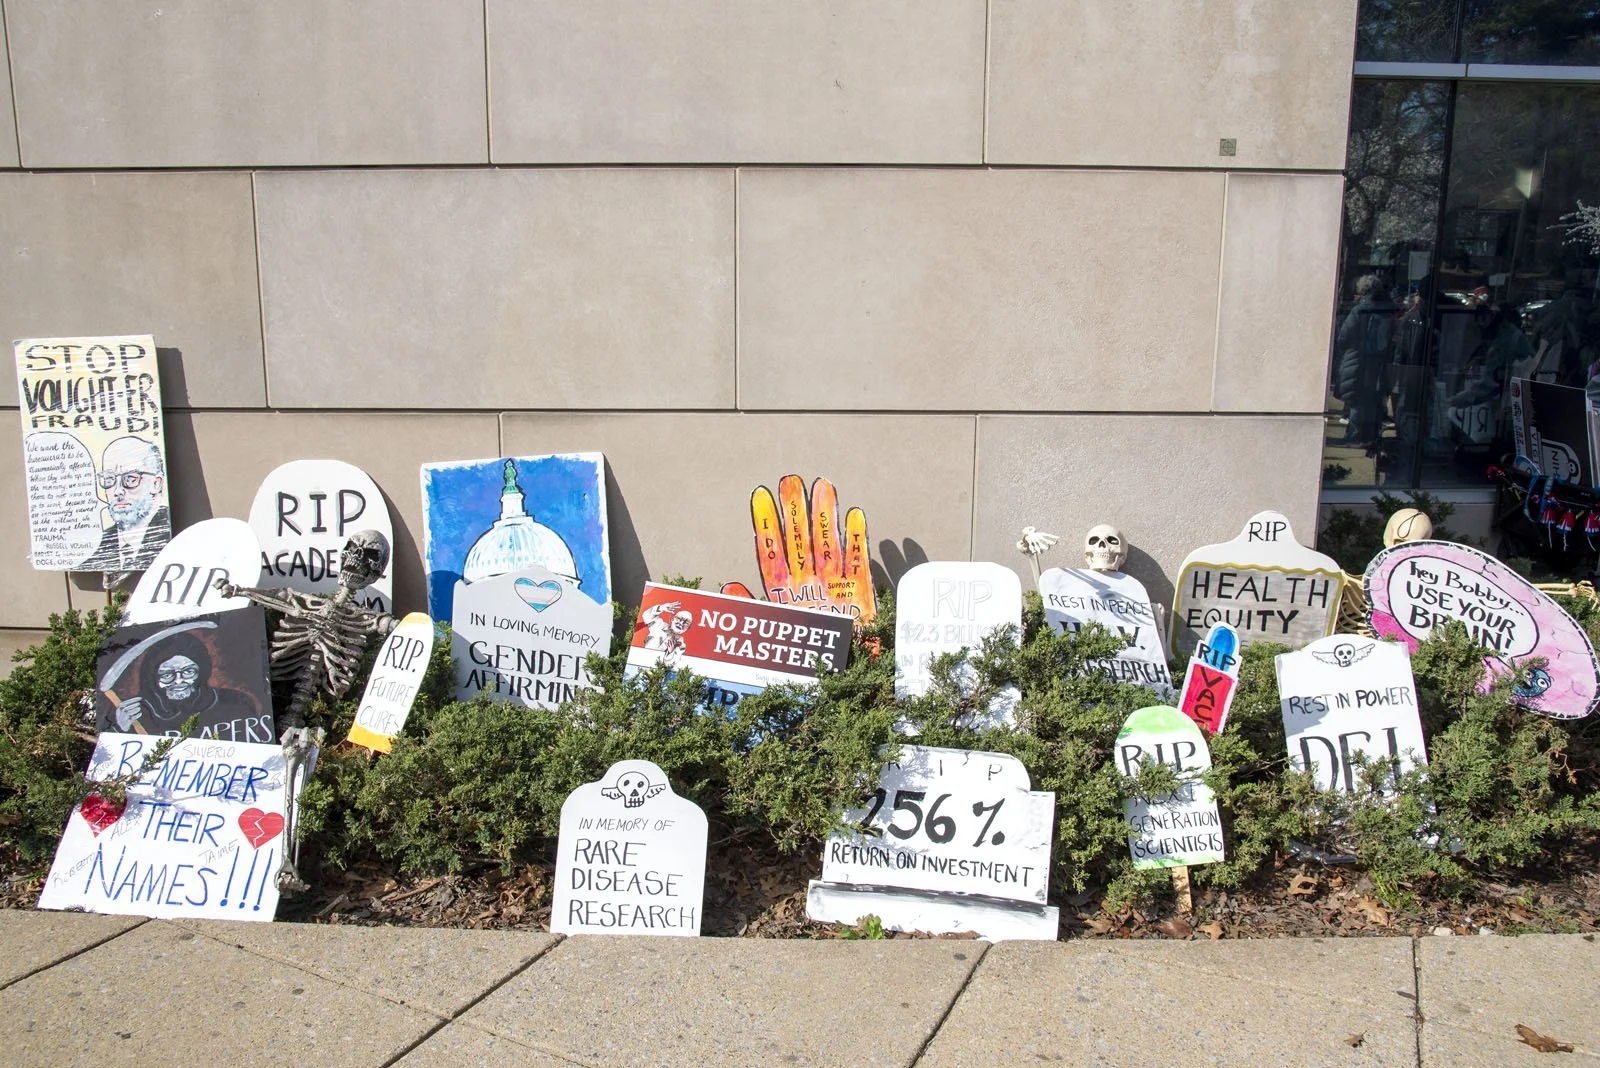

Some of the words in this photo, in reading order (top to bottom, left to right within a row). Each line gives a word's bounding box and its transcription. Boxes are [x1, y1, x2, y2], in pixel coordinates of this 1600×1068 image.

[25, 344, 146, 374] STOP
[62, 440, 75, 450] the
[76, 450, 84, 458] be
[277, 489, 366, 537] RIP
[763, 519, 768, 529] I
[790, 501, 805, 570] SOLEMNLY
[820, 512, 832, 561] SWEAR
[1248, 521, 1286, 542] RIP
[261, 547, 338, 582] ACADE
[851, 534, 861, 575] THAT
[150, 563, 230, 607] RIP
[772, 588, 787, 604] I
[789, 585, 827, 602] WILL
[827, 582, 855, 590] SUPPORT
[836, 591, 853, 599] AND
[933, 577, 992, 620] RIP
[1192, 570, 1329, 608] HEALTH
[1049, 594, 1085, 609] REST
[1091, 599, 1106, 611] IN
[1109, 600, 1149, 615] PEACE
[1406, 581, 1453, 611] USE
[1458, 598, 1516, 641] YOUR
[470, 612, 486, 626] IN
[494, 616, 540, 636] LOVING
[543, 625, 600, 648] MEMORY
[698, 609, 737, 634] NO
[741, 616, 841, 649] PUPPET
[1187, 608, 1299, 634] EQUITY
[469, 640, 591, 682] GENDER
[714, 635, 839, 673] MASTERS.
[1198, 643, 1236, 671] RIP
[464, 669, 594, 703] AFFIRMIN
[1082, 660, 1168, 684] ESEARCH
[369, 676, 414, 708] FUTURE
[1289, 693, 1333, 714] REST
[1336, 693, 1350, 709] IN
[1356, 686, 1413, 708] POWER
[165, 715, 272, 743] APERS
[360, 705, 399, 734] CURES
[181, 744, 235, 758] SILVERIO
[1121, 741, 1196, 776] RIP
[139, 801, 225, 847] THEIR
[578, 817, 593, 831] IN
[596, 817, 648, 831] MEMORY
[654, 820, 675, 831] OF
[1130, 808, 1219, 833] GENERATION
[198, 839, 238, 866] JAIME
[575, 838, 646, 866] RARE
[1134, 832, 1223, 858] SCIENTISTS
[831, 842, 889, 866] RETURN
[896, 852, 917, 870] ON
[922, 854, 1034, 887] INVESTMENT
[572, 868, 683, 896] DISEASE
[569, 899, 695, 929] RESEARCH
